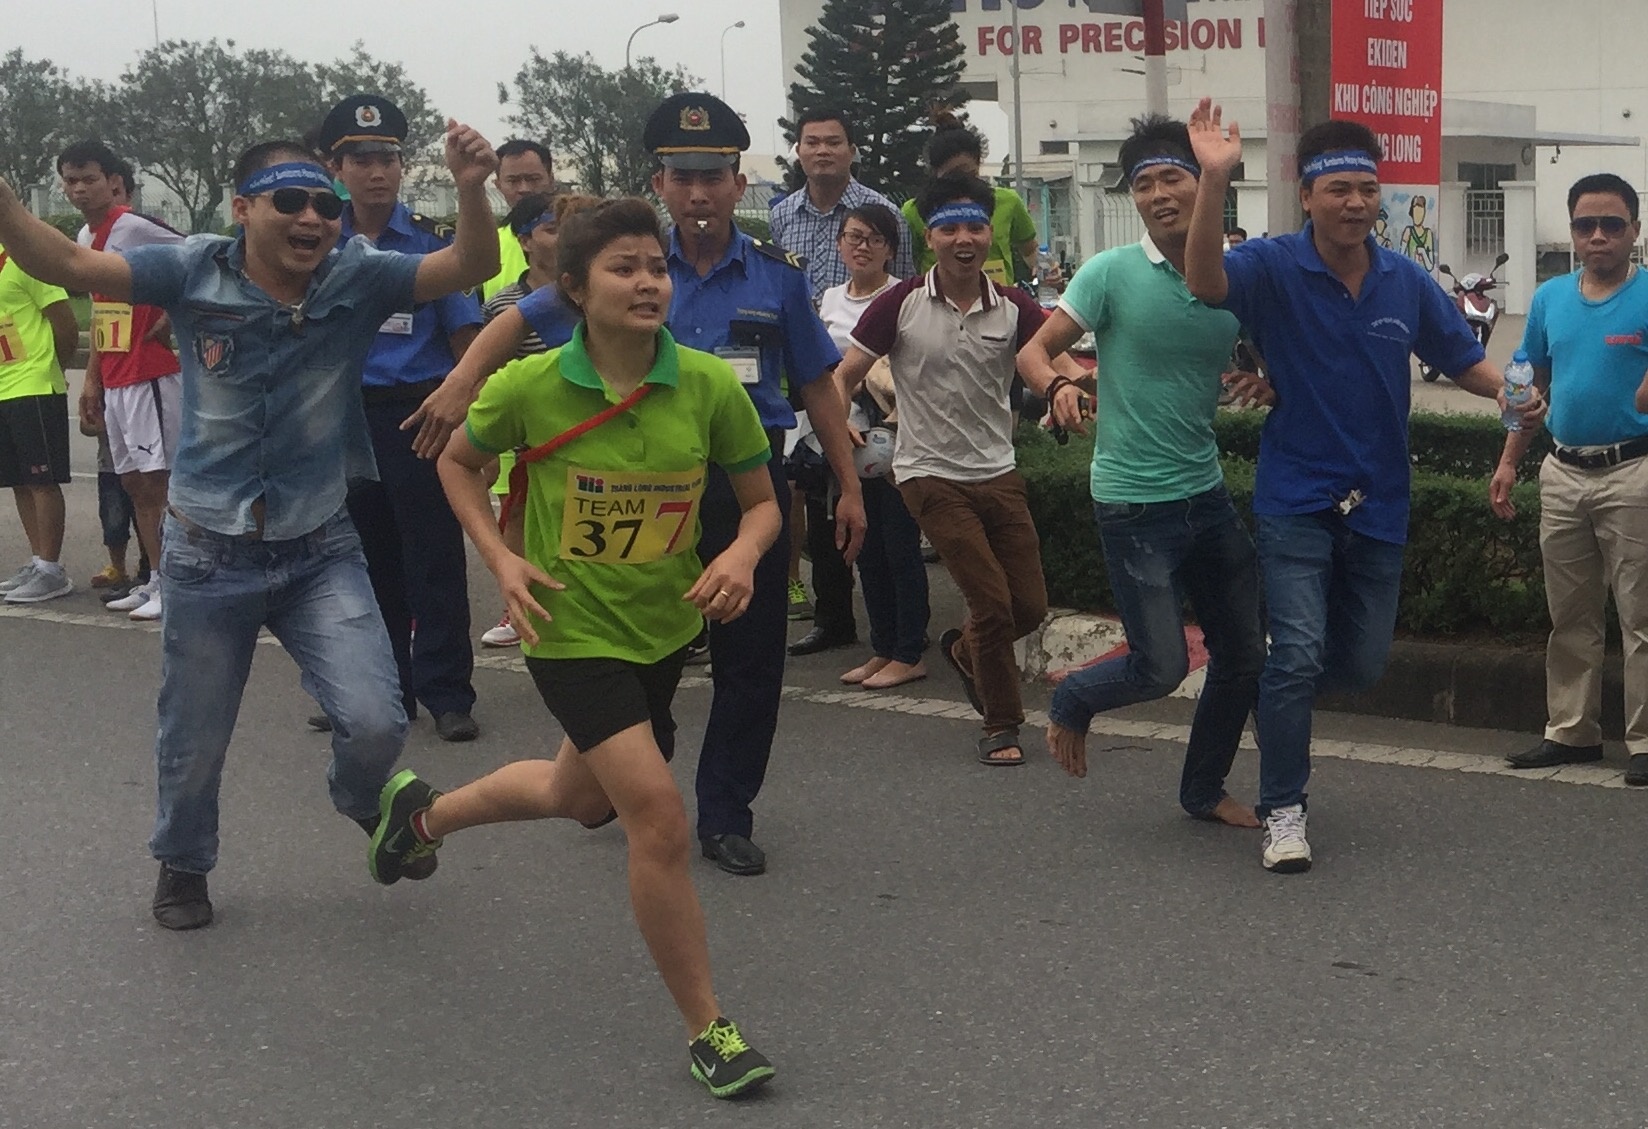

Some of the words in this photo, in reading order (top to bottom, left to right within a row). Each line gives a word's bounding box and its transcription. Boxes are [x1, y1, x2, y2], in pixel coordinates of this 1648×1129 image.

[977, 25, 1042, 56] FOR
[1059, 18, 1242, 54] PRECSION
[1367, 37, 1407, 69] EKIDEN
[1334, 83, 1360, 113] KHU
[1362, 79, 1393, 115] CÔNG
[1394, 84, 1438, 123] NGHIỆP
[1391, 134, 1422, 163] LONG
[109, 320, 121, 348] 1
[573, 497, 645, 517] TEAM
[569, 518, 644, 559] 37
[655, 499, 693, 554] 7
